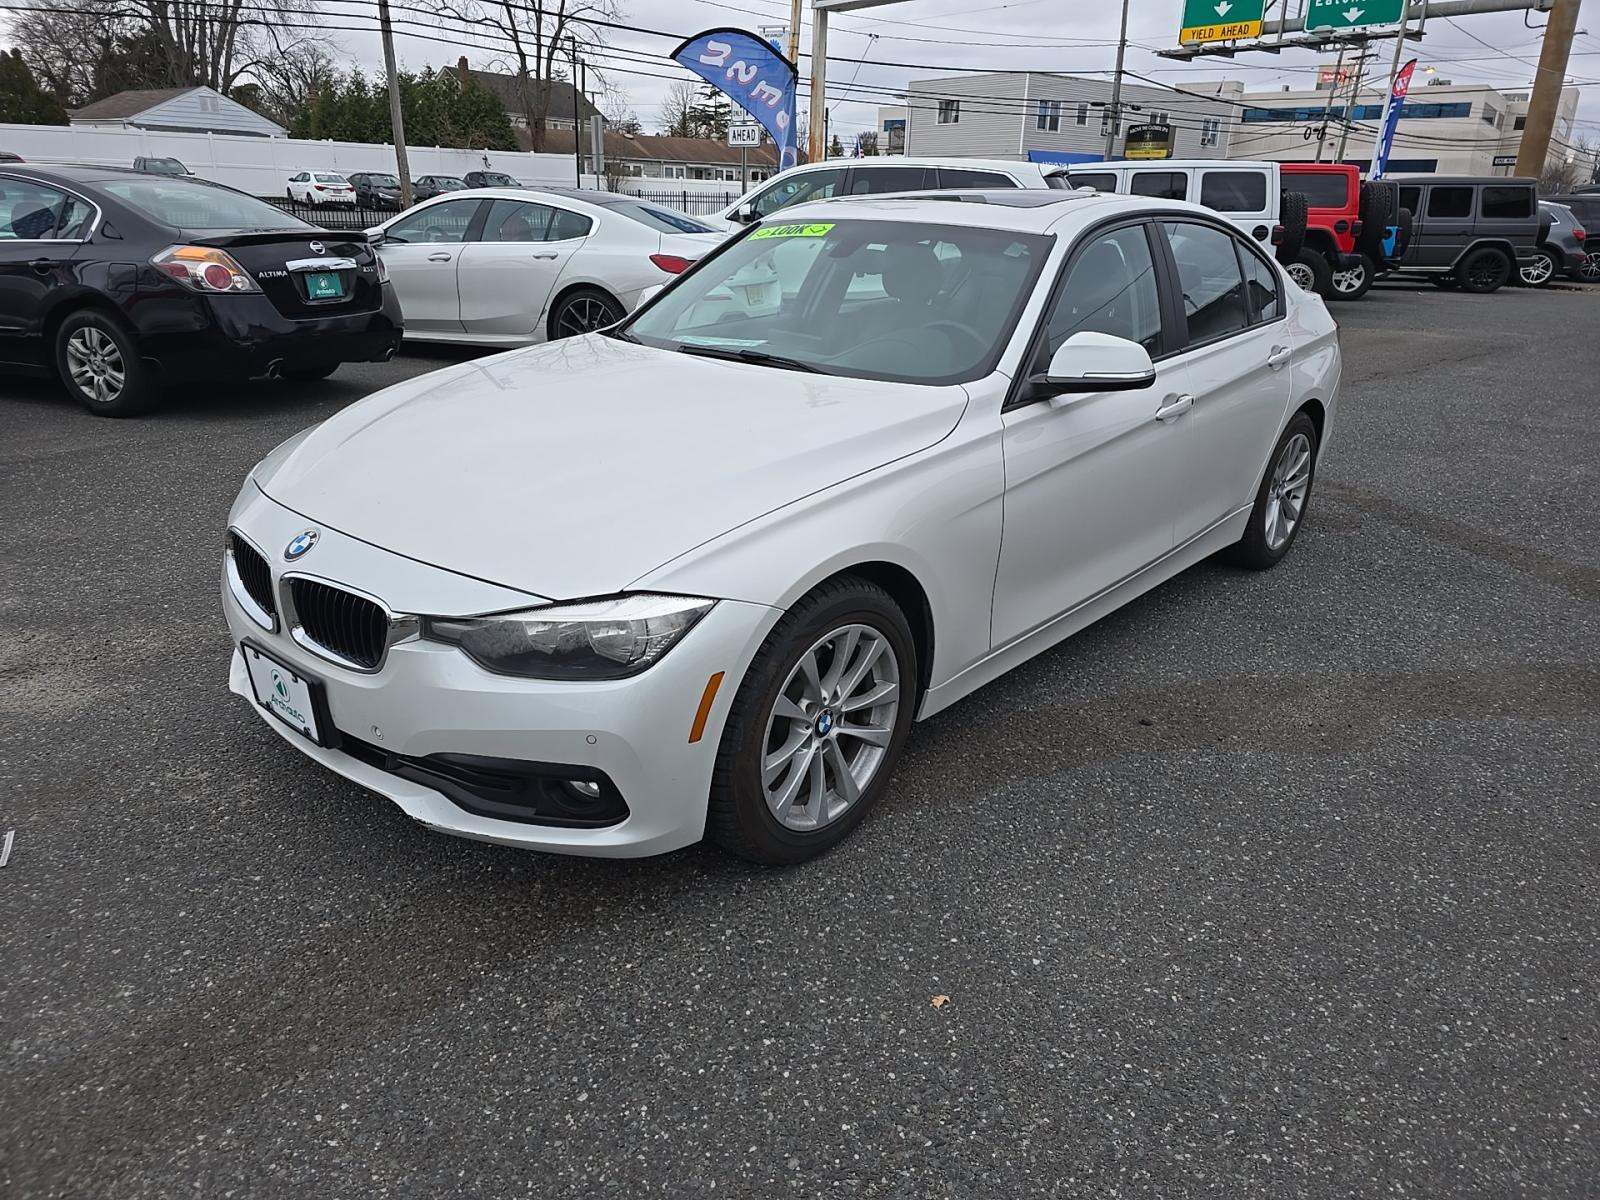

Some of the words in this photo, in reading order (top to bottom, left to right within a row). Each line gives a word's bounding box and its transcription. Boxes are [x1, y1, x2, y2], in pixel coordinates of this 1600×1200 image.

[1191, 28, 1214, 40] YIELD
[1220, 24, 1250, 37] AHEAD
[732, 129, 756, 141] AHEAD
[769, 225, 806, 236] LOOK
[258, 270, 288, 278] ALTIMA
